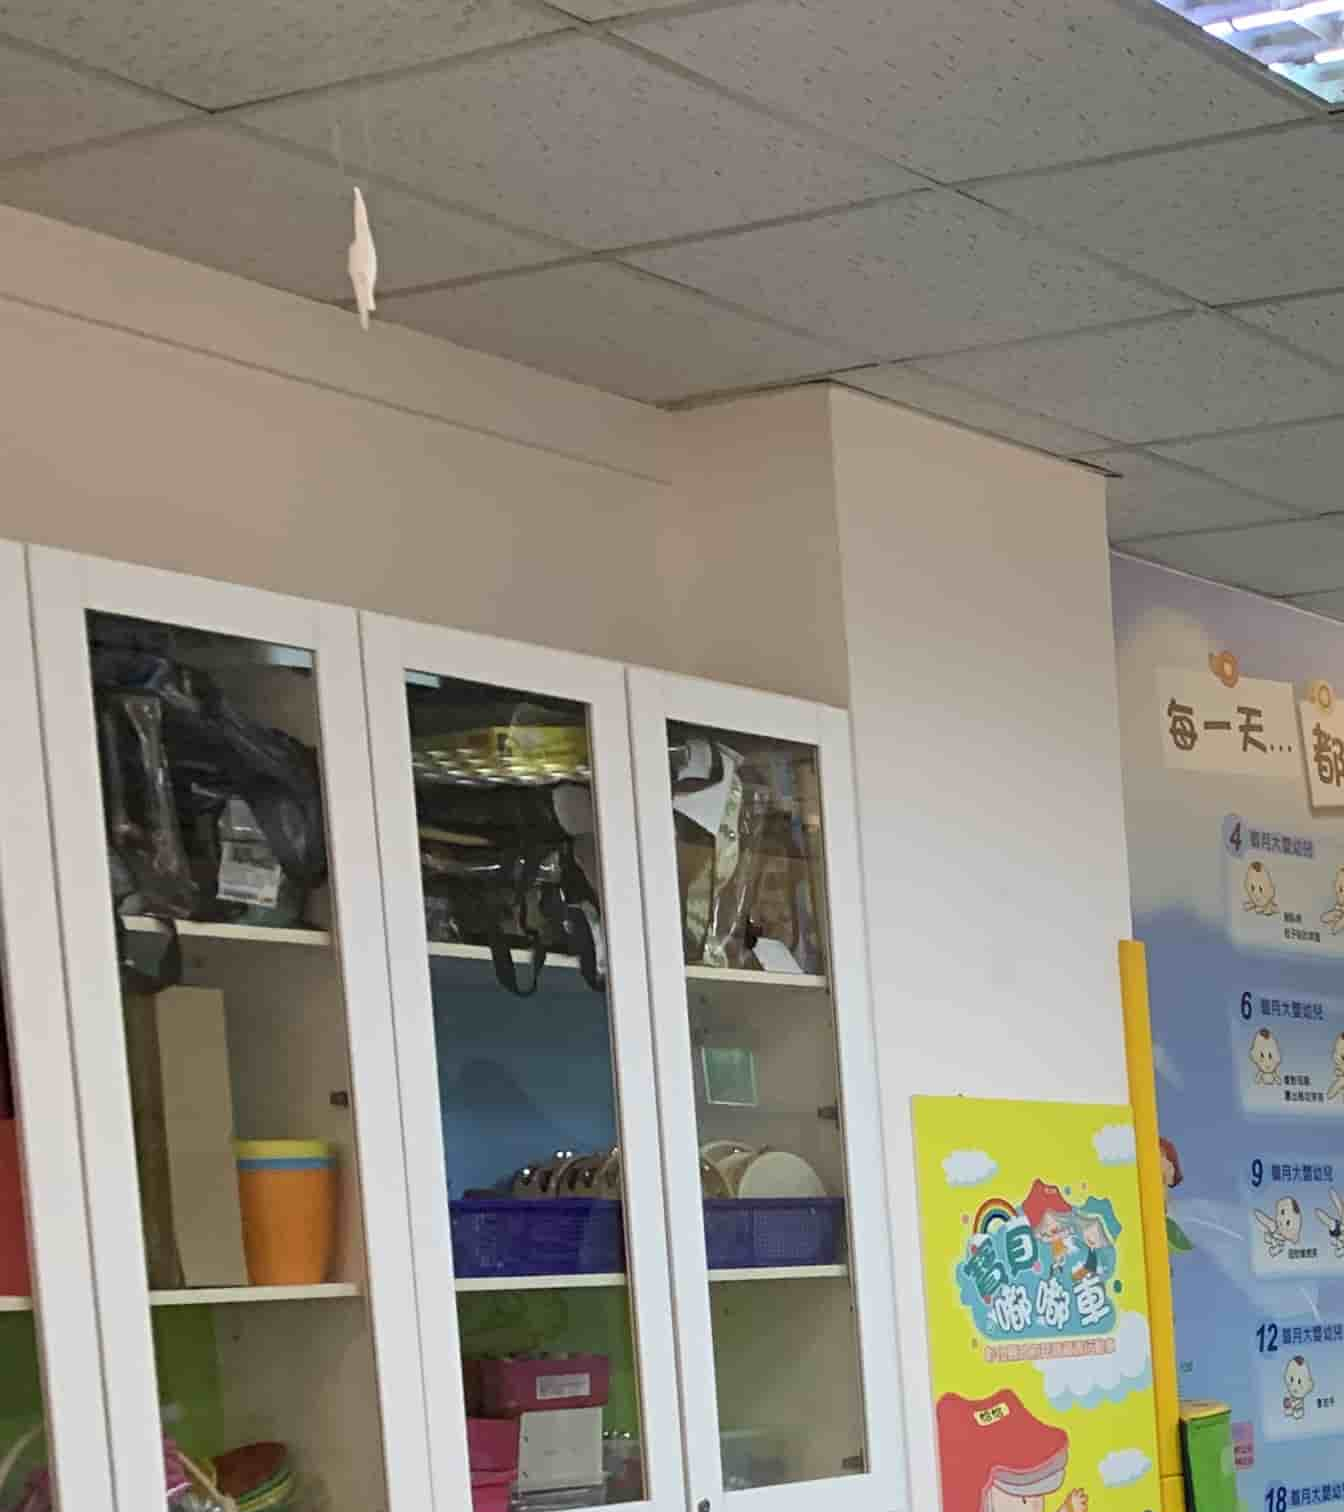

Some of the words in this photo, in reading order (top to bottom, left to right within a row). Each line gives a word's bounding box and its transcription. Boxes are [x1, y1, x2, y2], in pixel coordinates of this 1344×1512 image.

[1229, 823, 1241, 851] 4
[1240, 991, 1252, 1021] 6
[1251, 1158, 1263, 1187] 9
[1256, 1322, 1279, 1352] 12
